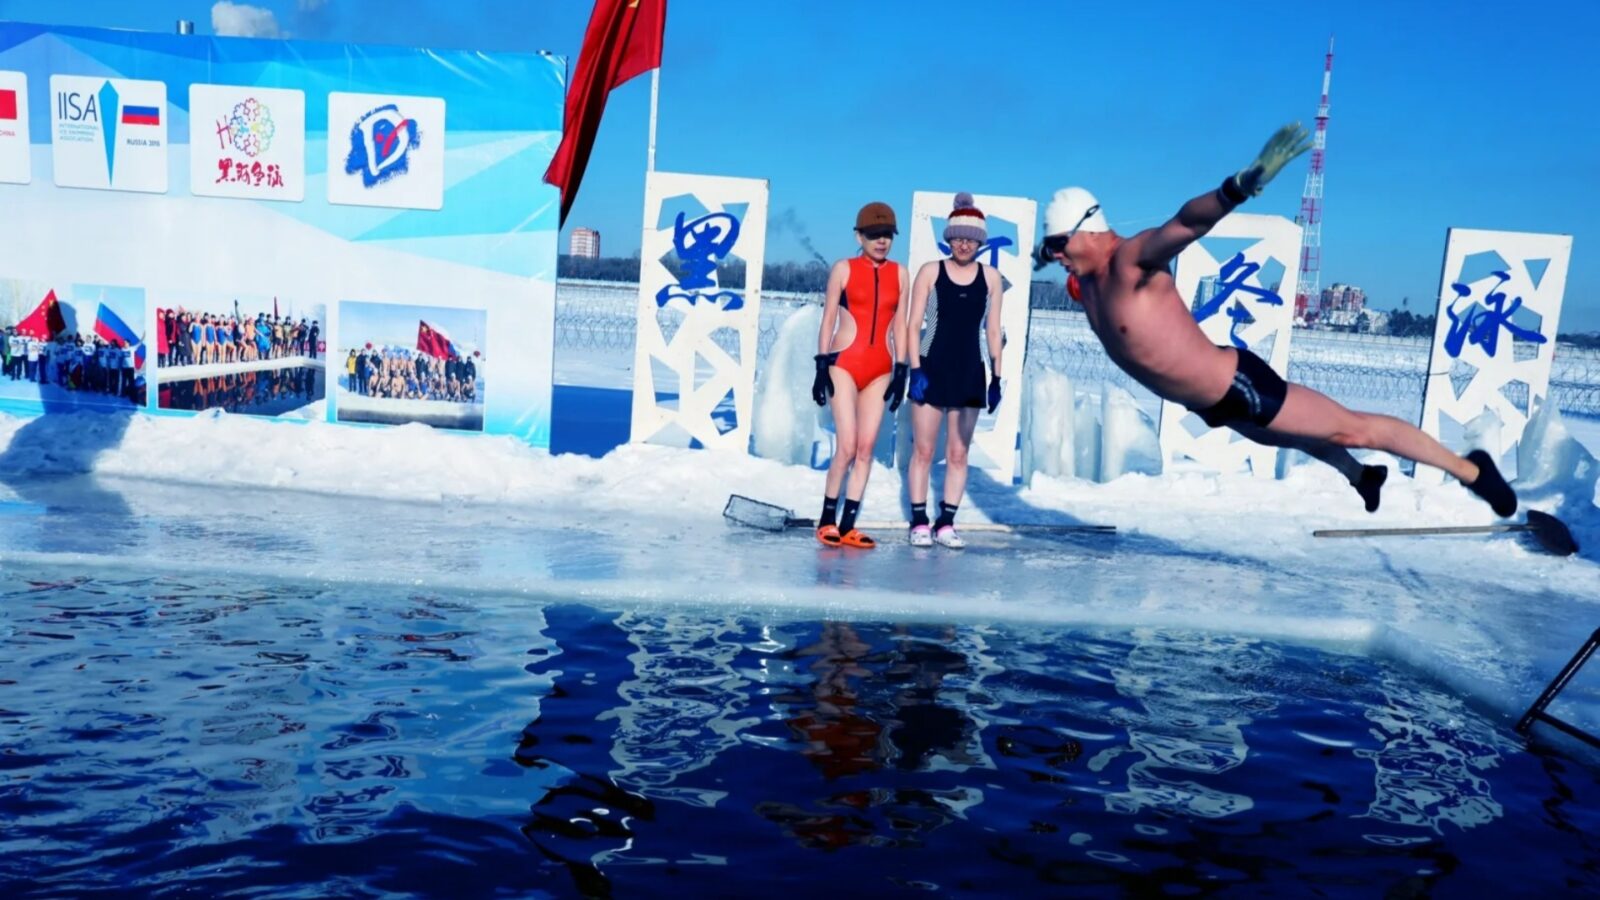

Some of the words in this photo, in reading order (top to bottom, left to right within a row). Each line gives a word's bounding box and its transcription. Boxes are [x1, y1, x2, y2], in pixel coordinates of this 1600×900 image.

[58, 91, 98, 122] IISA
[656, 211, 745, 311] 黑
[1444, 271, 1547, 357] 泳
